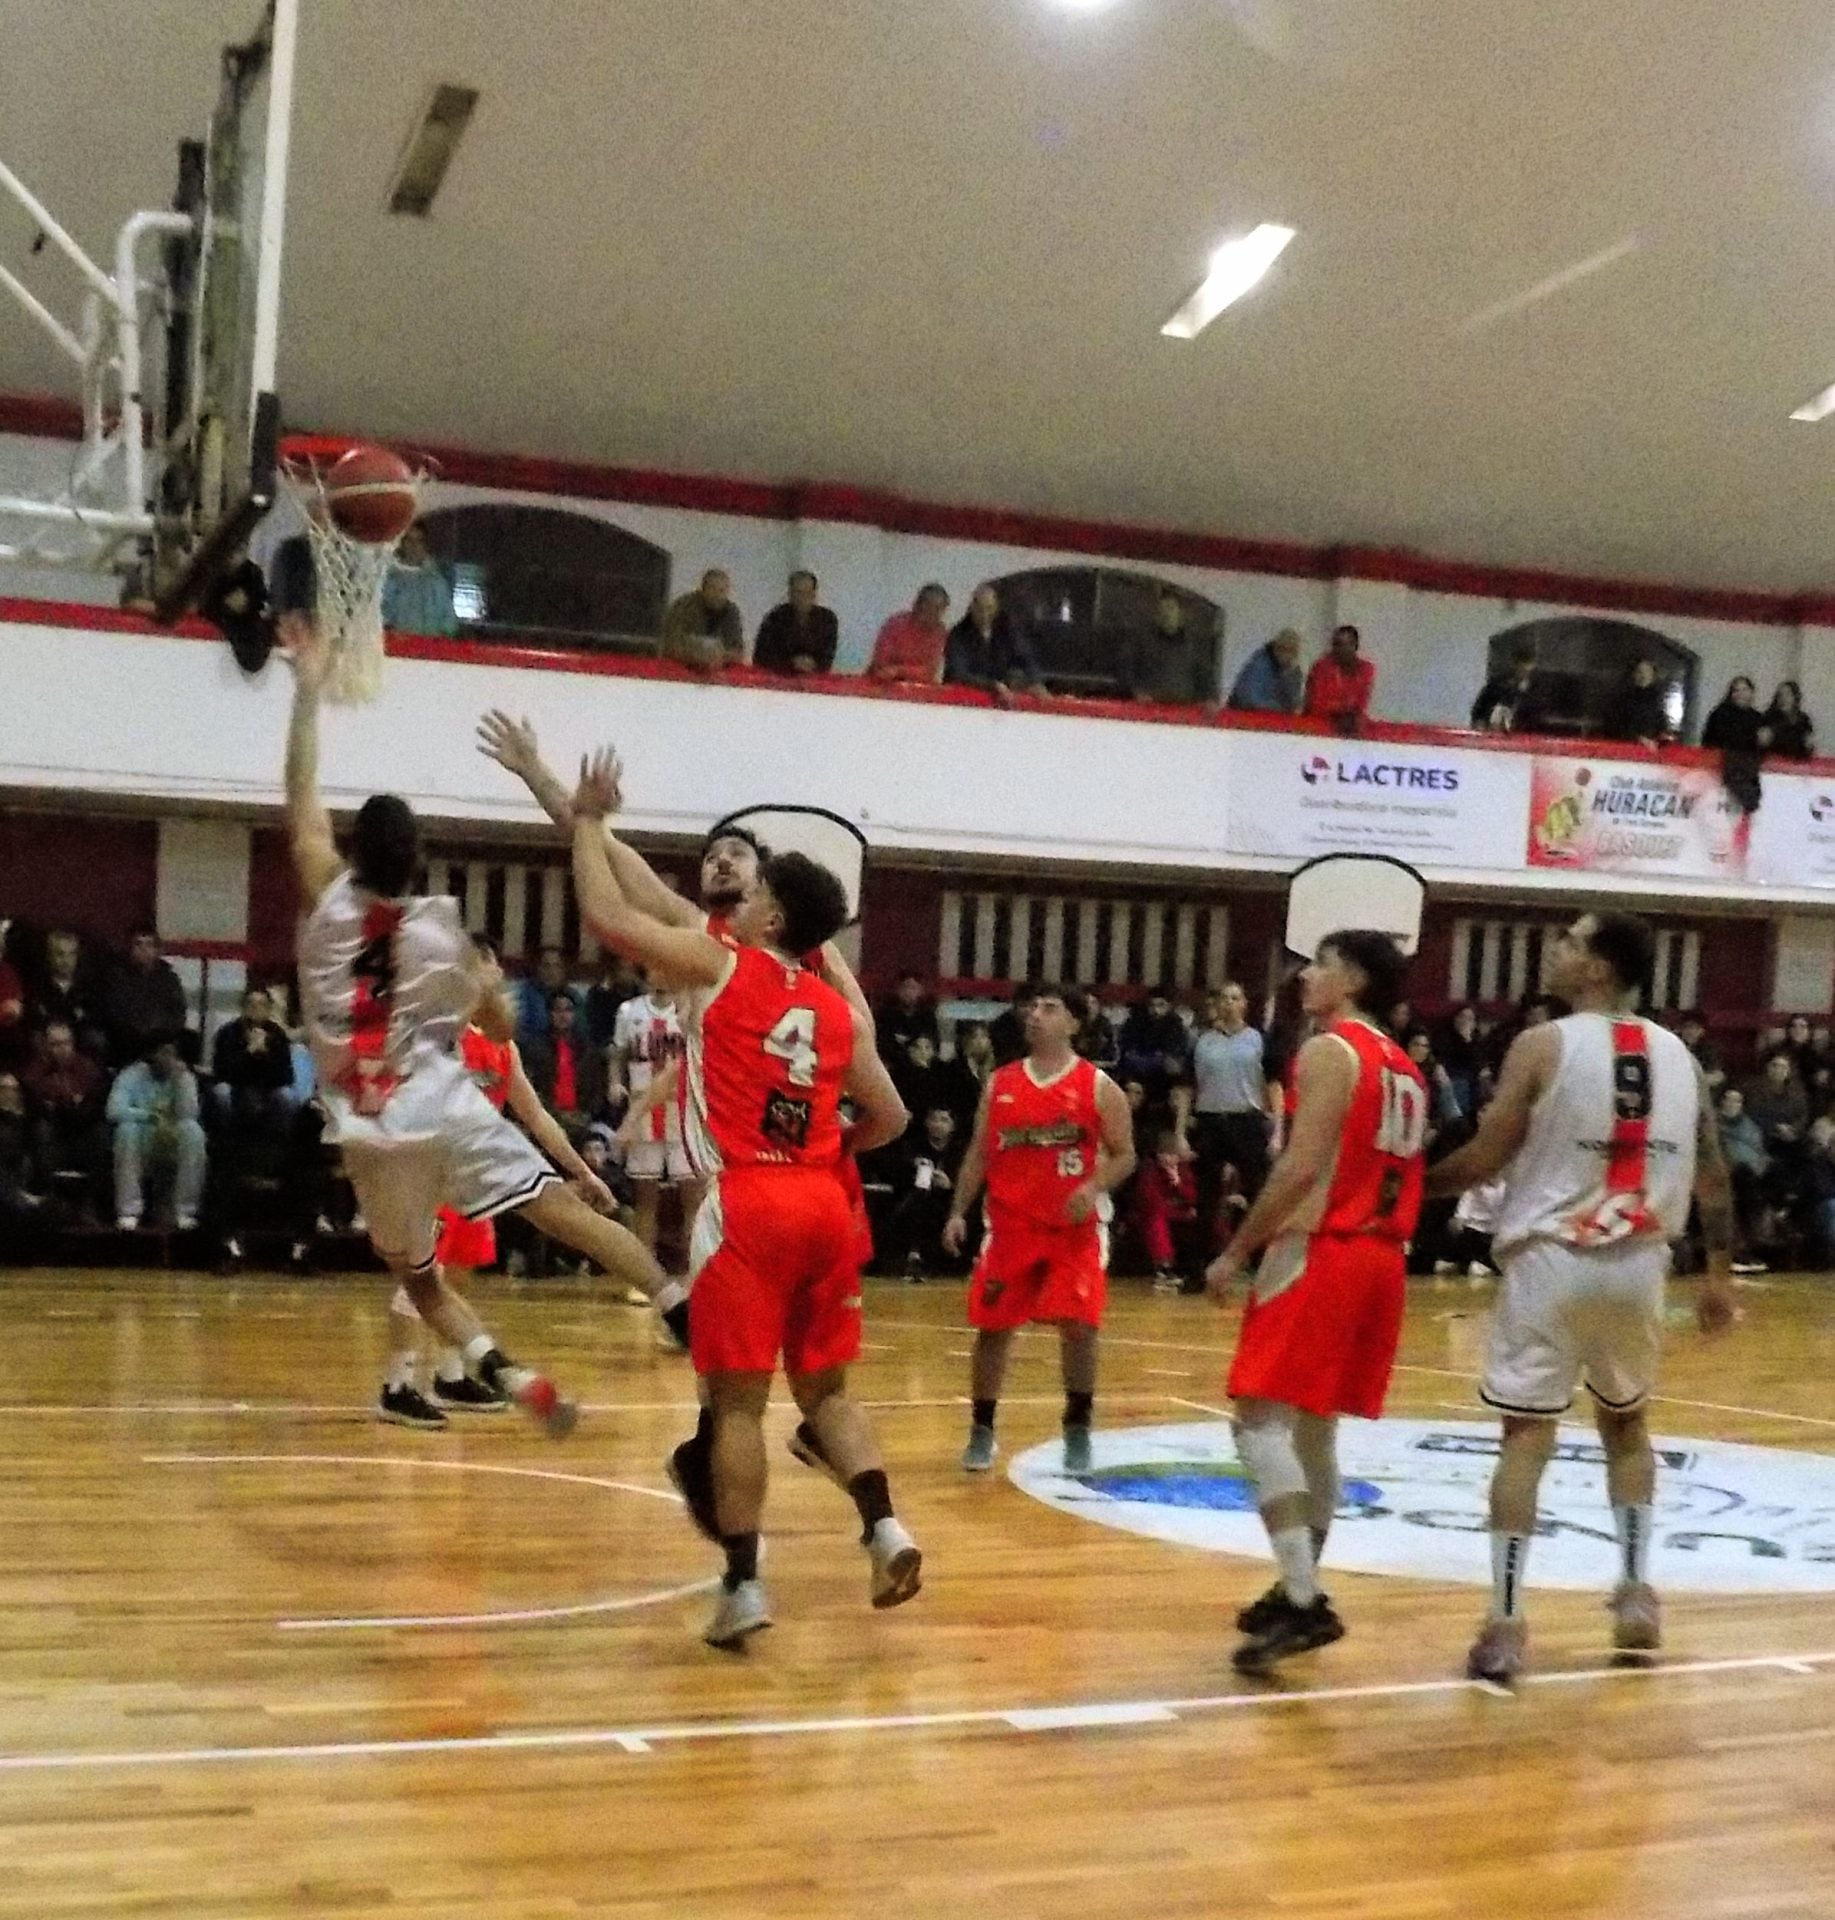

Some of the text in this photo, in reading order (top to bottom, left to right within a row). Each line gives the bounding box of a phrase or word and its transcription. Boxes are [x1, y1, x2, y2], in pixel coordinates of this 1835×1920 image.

[1337, 762, 1459, 791] LACTRES
[763, 1004, 818, 1088] 4
[1374, 1066, 1428, 1159] 10
[1615, 1055, 1651, 1119] 9
